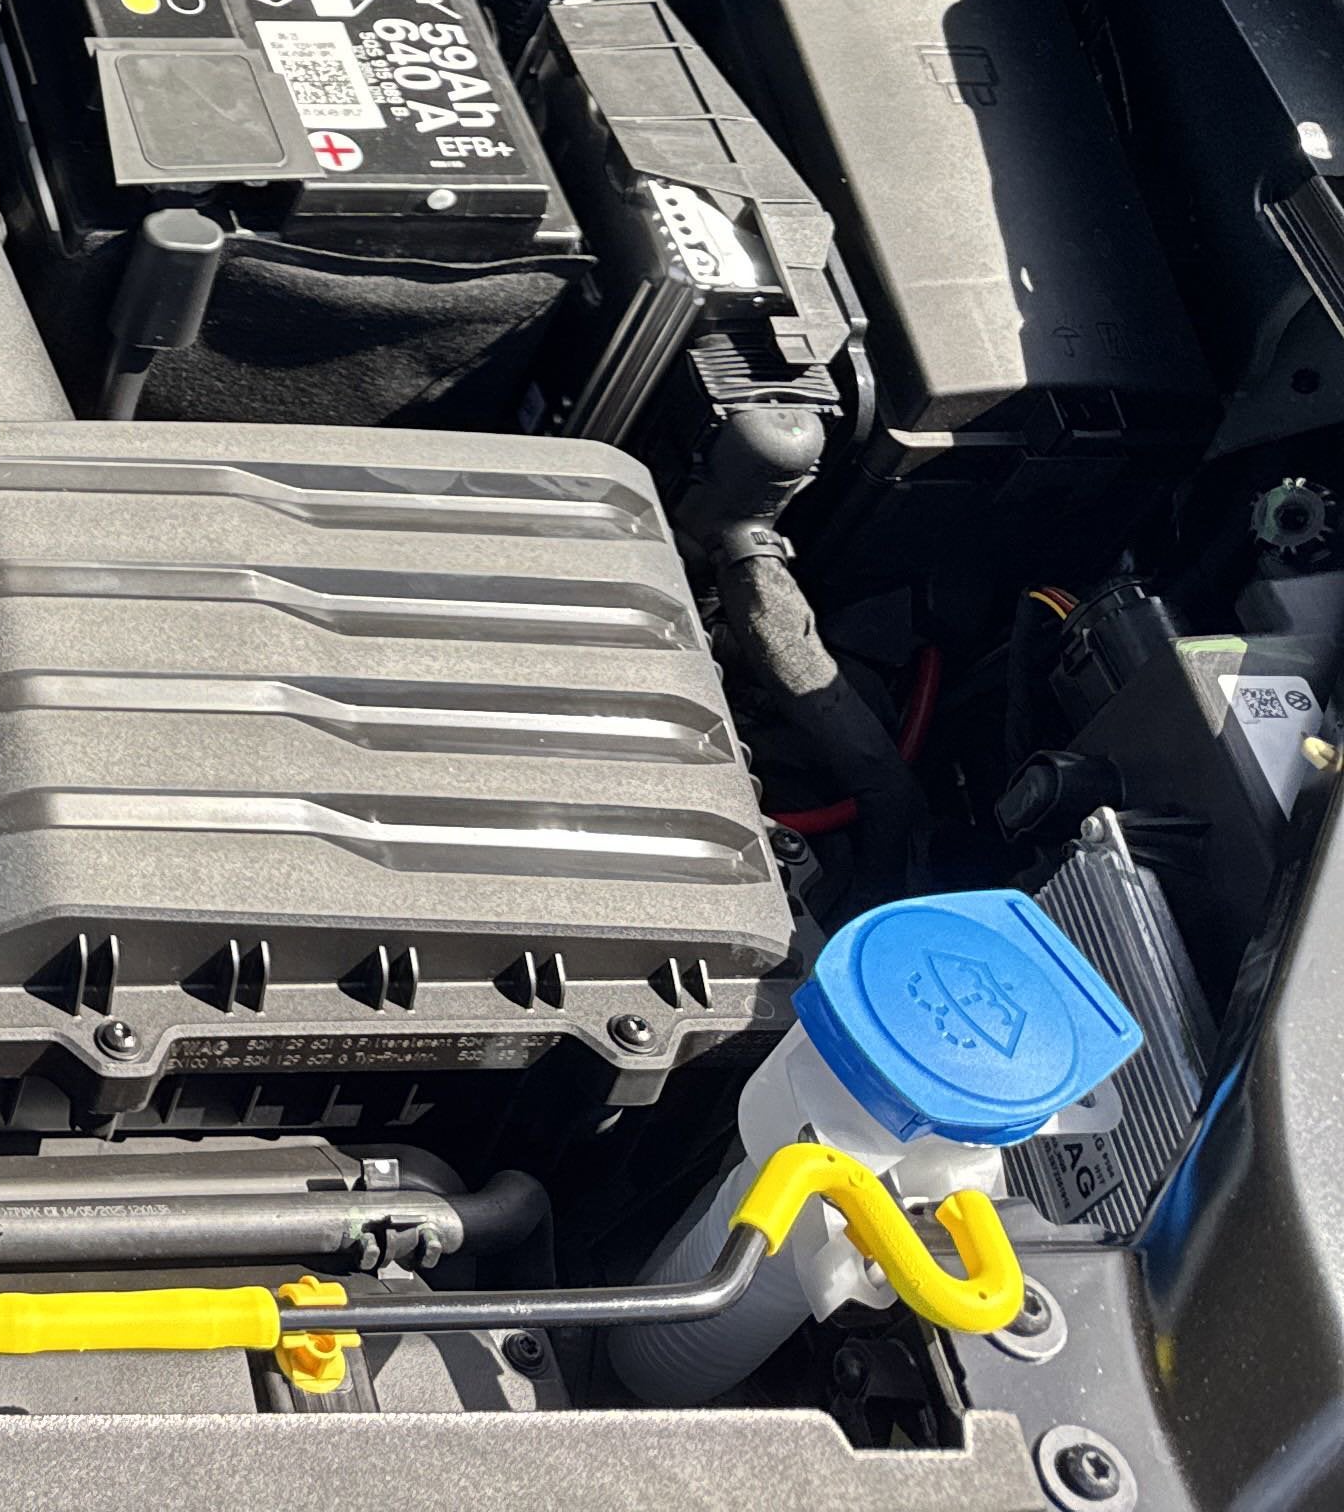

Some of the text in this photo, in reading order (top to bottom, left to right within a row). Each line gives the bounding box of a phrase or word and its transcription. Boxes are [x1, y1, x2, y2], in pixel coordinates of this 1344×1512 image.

[373, 18, 443, 91] 640
[420, 22, 502, 128] 59Ah
[406, 100, 460, 133] A
[435, 136, 516, 158] EFB+
